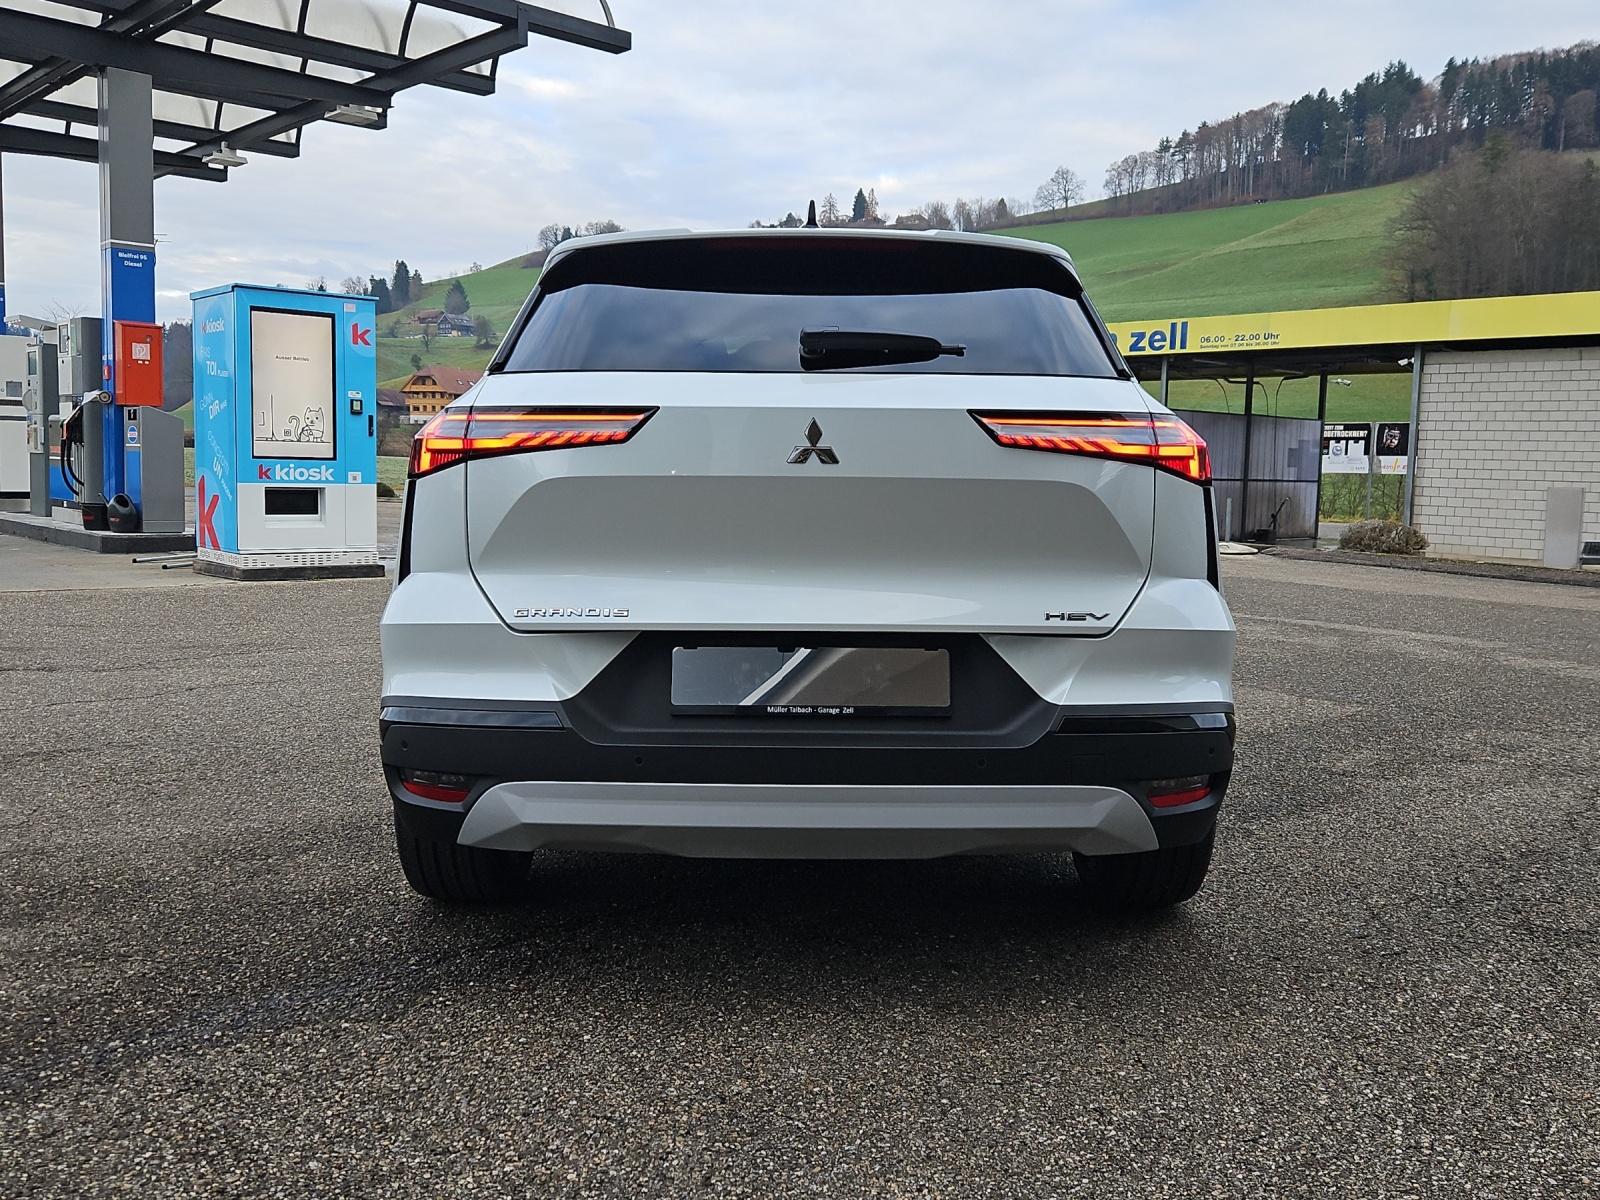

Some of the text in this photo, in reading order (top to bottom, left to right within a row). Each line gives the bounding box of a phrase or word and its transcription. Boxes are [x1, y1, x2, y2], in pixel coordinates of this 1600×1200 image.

[118, 251, 139, 259] Bleifrei
[206, 317, 225, 333] kiosk
[351, 323, 371, 346] k
[1129, 321, 1189, 352] zell
[1234, 333, 1260, 341] 22.00
[1263, 332, 1280, 340] Uhr
[206, 360, 217, 376] TOI
[209, 399, 220, 420] DIR
[258, 464, 334, 480] k kiosk
[198, 475, 221, 551] k
[513, 608, 630, 618] GRANDIS
[1044, 611, 1110, 621] HEV
[818, 707, 840, 715] Garage
